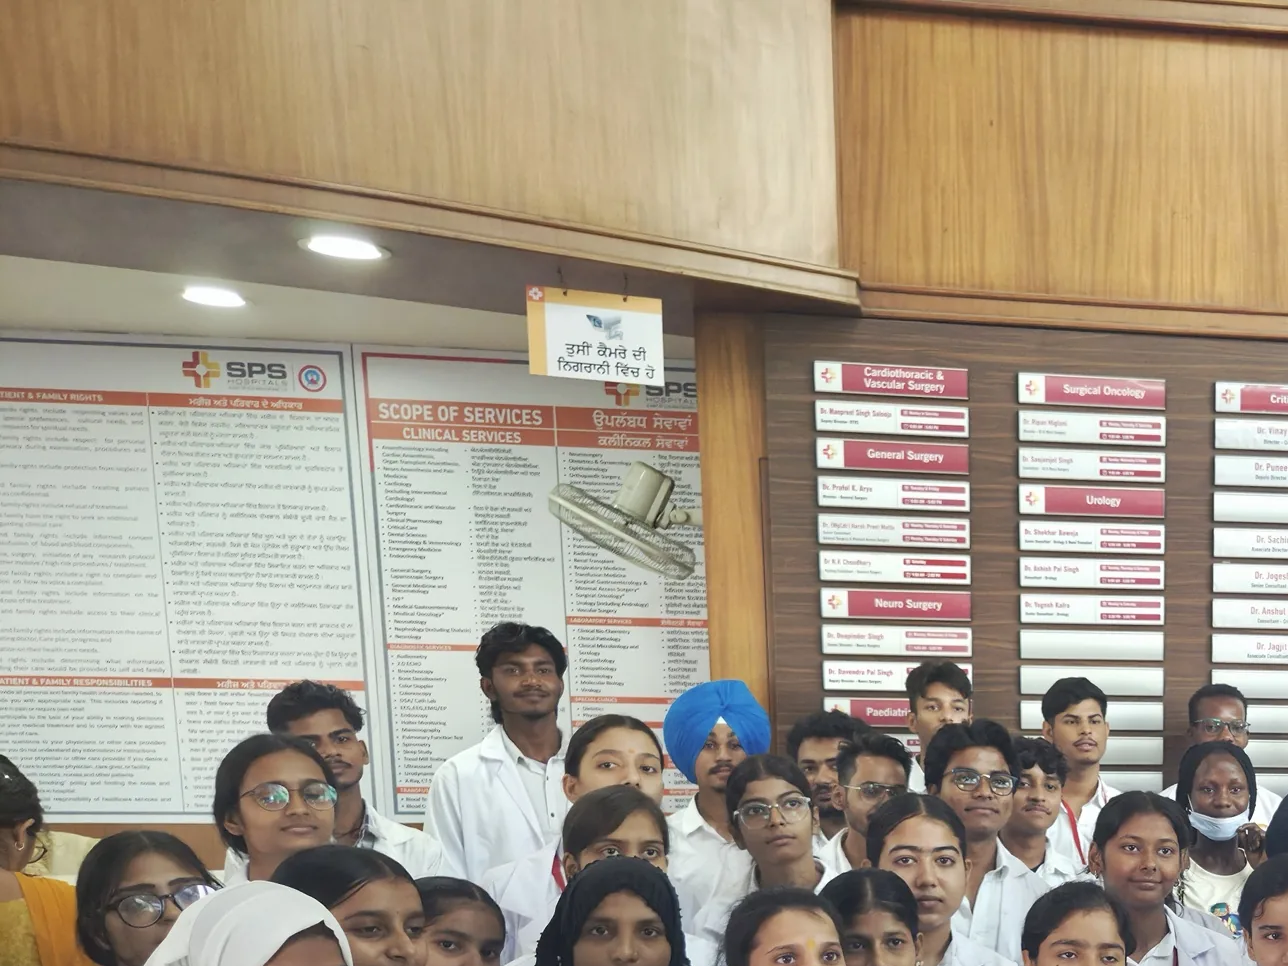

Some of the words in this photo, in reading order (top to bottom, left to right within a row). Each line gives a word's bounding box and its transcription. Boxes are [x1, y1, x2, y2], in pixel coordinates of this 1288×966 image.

[565, 341, 593, 358] ਤੁਸੀਂ
[597, 341, 627, 360] ਕੈਮਰੇ
[632, 347, 646, 362] ਦੀ
[226, 361, 287, 379] SPS
[557, 356, 610, 376] ਨਿਗਰਾਨੀ
[615, 362, 640, 378] ਵਿੱਚ
[645, 365, 657, 380] ਹੋ
[864, 366, 934, 380] Cardiothoracic
[936, 371, 944, 381] &
[227, 379, 288, 387] HOSPITALS
[864, 378, 905, 390] Vascular
[908, 380, 944, 393] Surgery
[36, 392, 68, 401] FAMILY
[70, 394, 104, 402] RIGHTS
[1063, 384, 1100, 396] Surgical
[1103, 386, 1146, 399] Oncology
[378, 402, 433, 421] SCOPE
[437, 406, 459, 422] OF
[464, 407, 543, 426] SERVICES
[402, 427, 460, 441] CLINICAL
[462, 430, 522, 443] SERVICES
[1269, 427, 1287, 436] Vinay
[867, 449, 904, 460] General
[907, 450, 944, 463] Surgery
[1255, 462, 1264, 471] Dr.
[1086, 495, 1122, 507] Urology
[1256, 535, 1266, 544] Dr.
[1255, 571, 1264, 579] Dr.
[874, 598, 903, 608] Neuro
[906, 599, 942, 612] Surgery
[1250, 607, 1260, 615] Dr.
[32, 678, 38, 686] &
[40, 678, 72, 687] FAMILY
[73, 679, 152, 688] RESPONSIBILITIES
[866, 707, 912, 717] Paediatri
